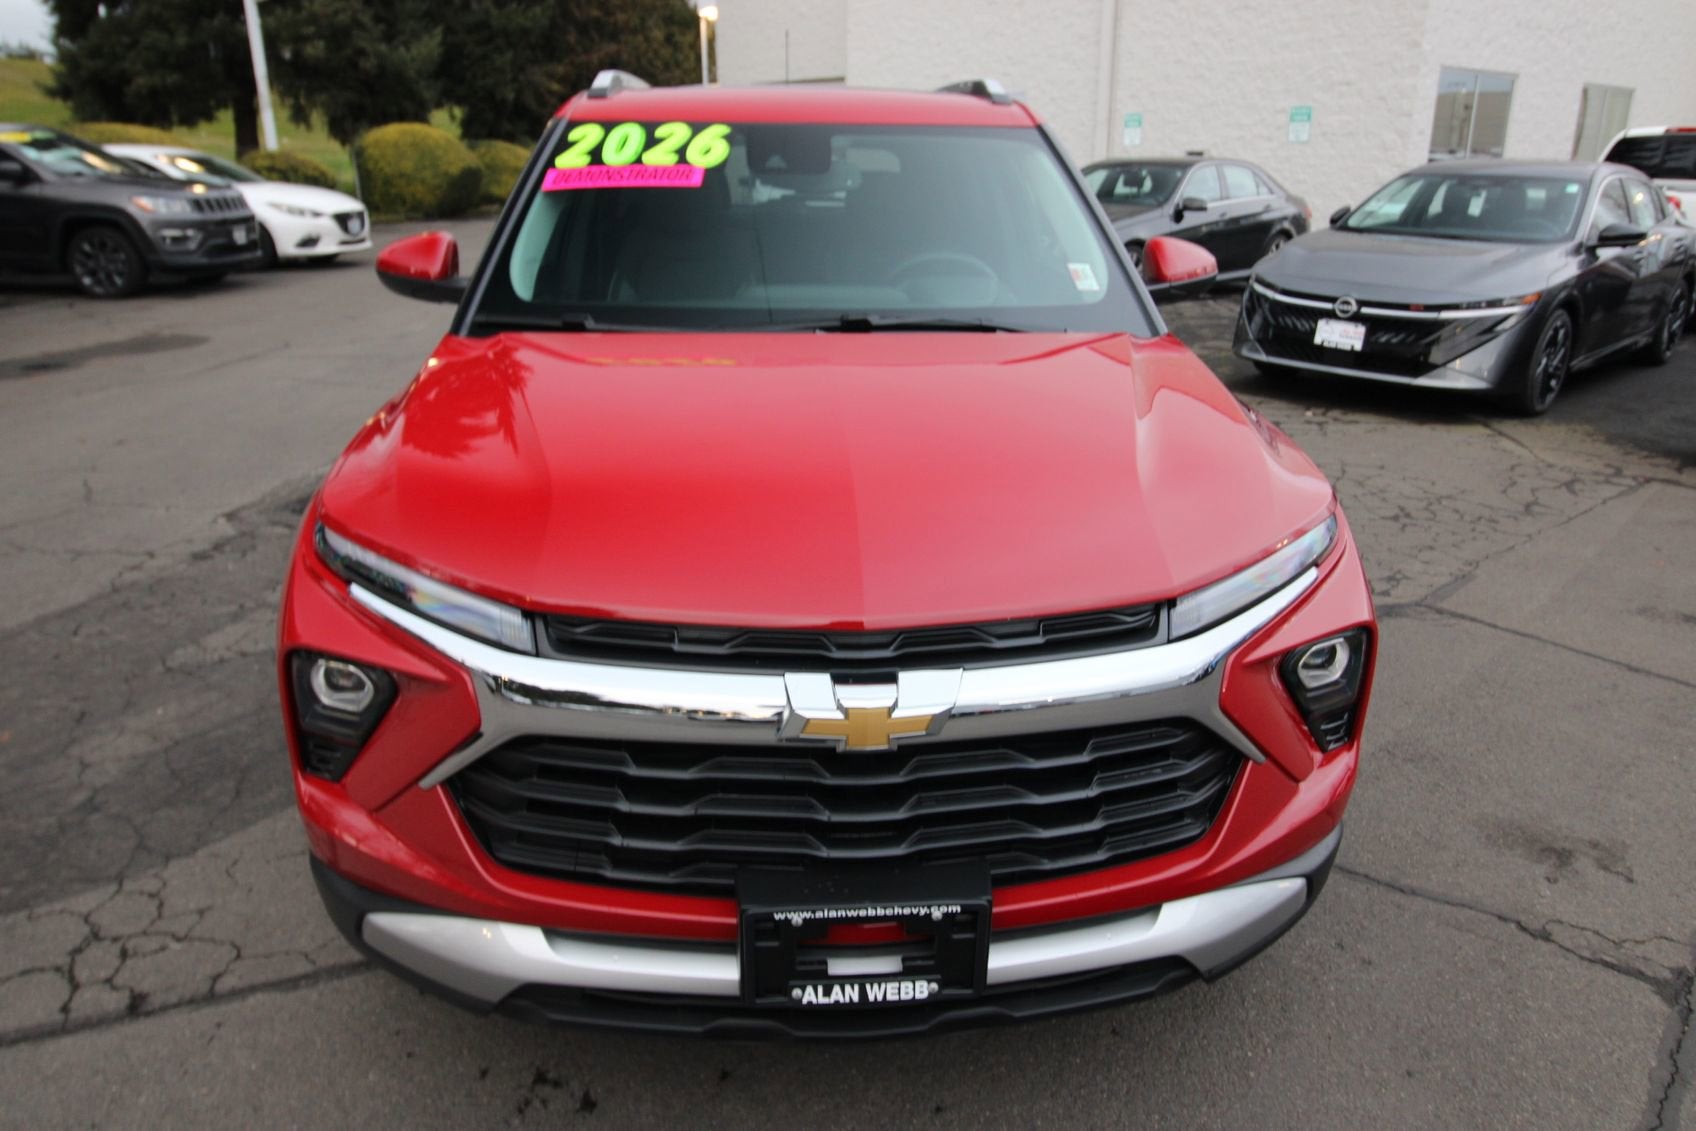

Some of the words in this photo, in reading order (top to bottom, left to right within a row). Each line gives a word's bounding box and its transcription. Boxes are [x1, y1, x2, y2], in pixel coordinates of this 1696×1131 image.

[554, 121, 732, 169] 2026
[553, 166, 694, 185] DEMONSTRATOR
[802, 983, 860, 1005] ALAN
[865, 980, 929, 1002] WEBB
